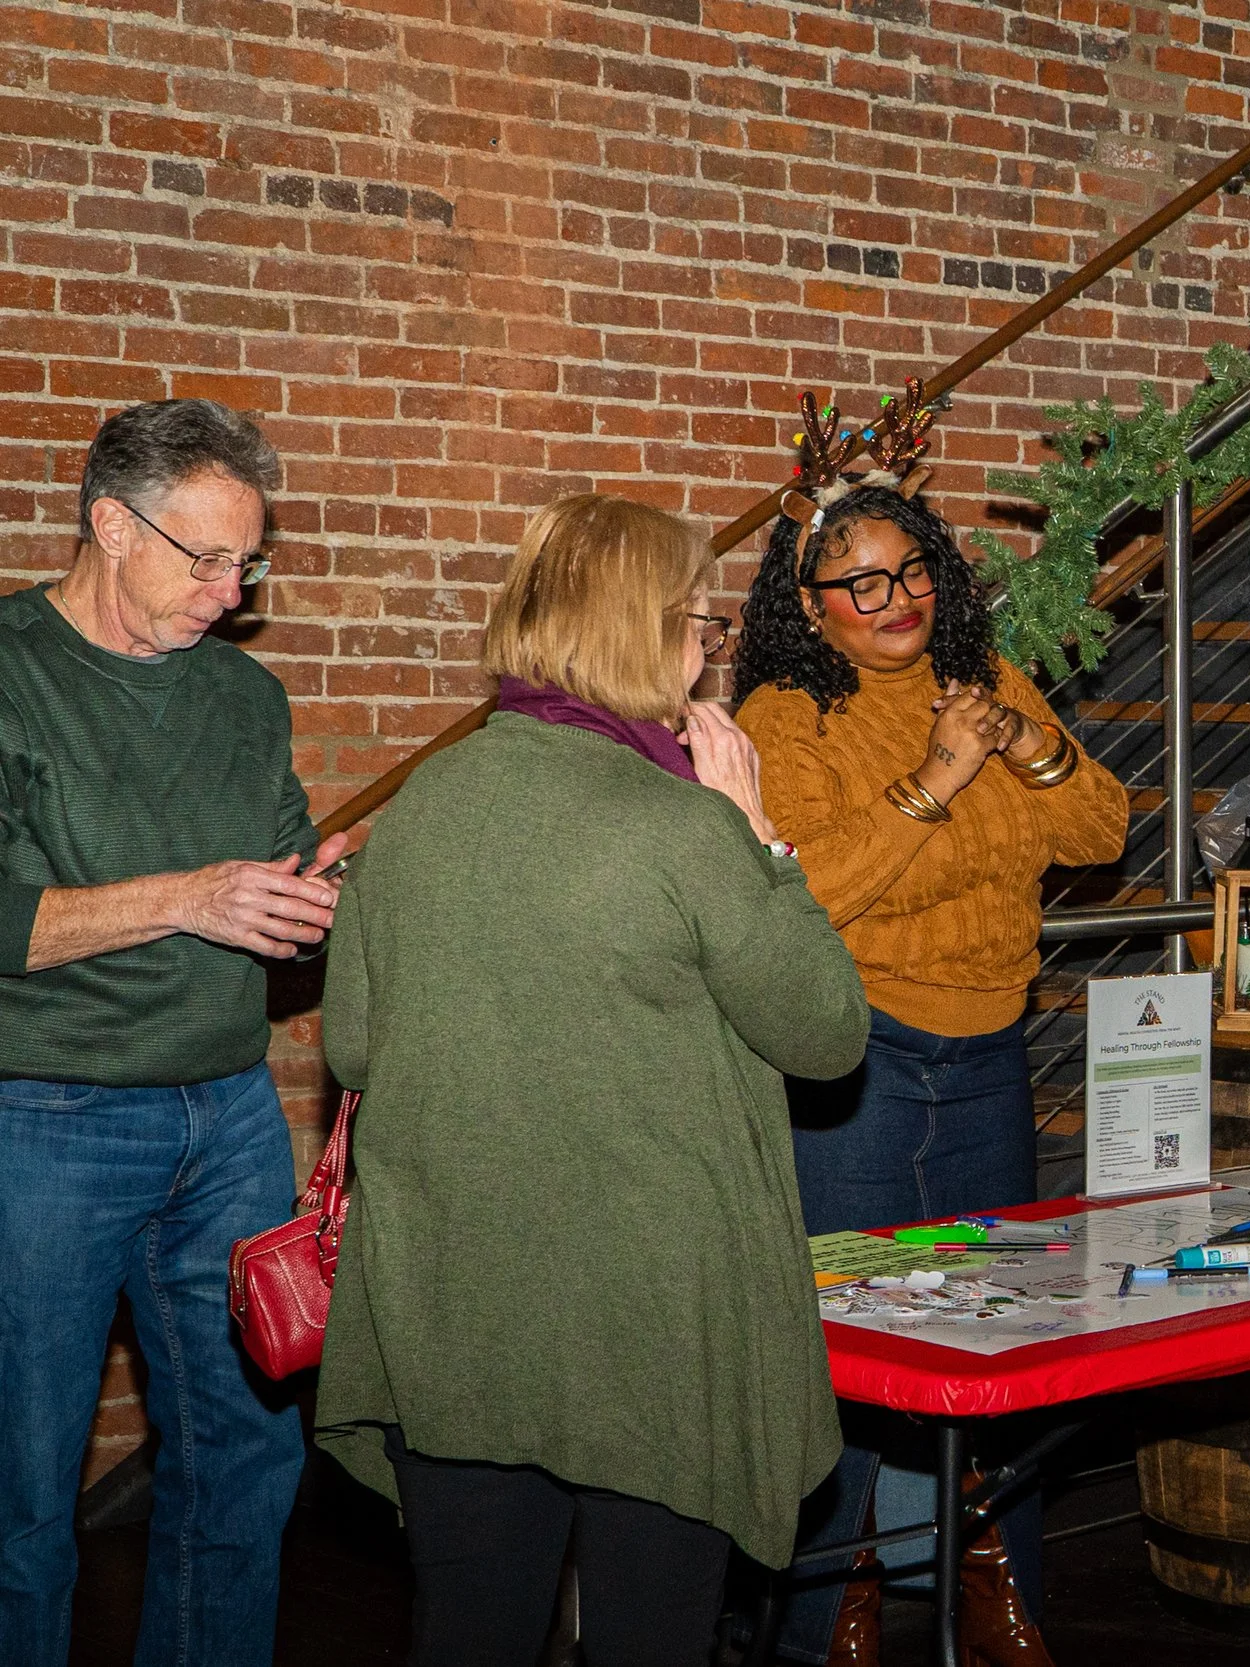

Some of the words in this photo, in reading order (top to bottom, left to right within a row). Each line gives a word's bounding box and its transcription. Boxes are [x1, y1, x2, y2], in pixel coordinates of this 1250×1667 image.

[1146, 989, 1166, 1004] STAND
[1100, 1043, 1129, 1055] Healing
[1131, 1040, 1162, 1052] Through
[1163, 1037, 1202, 1050] Fellowship
